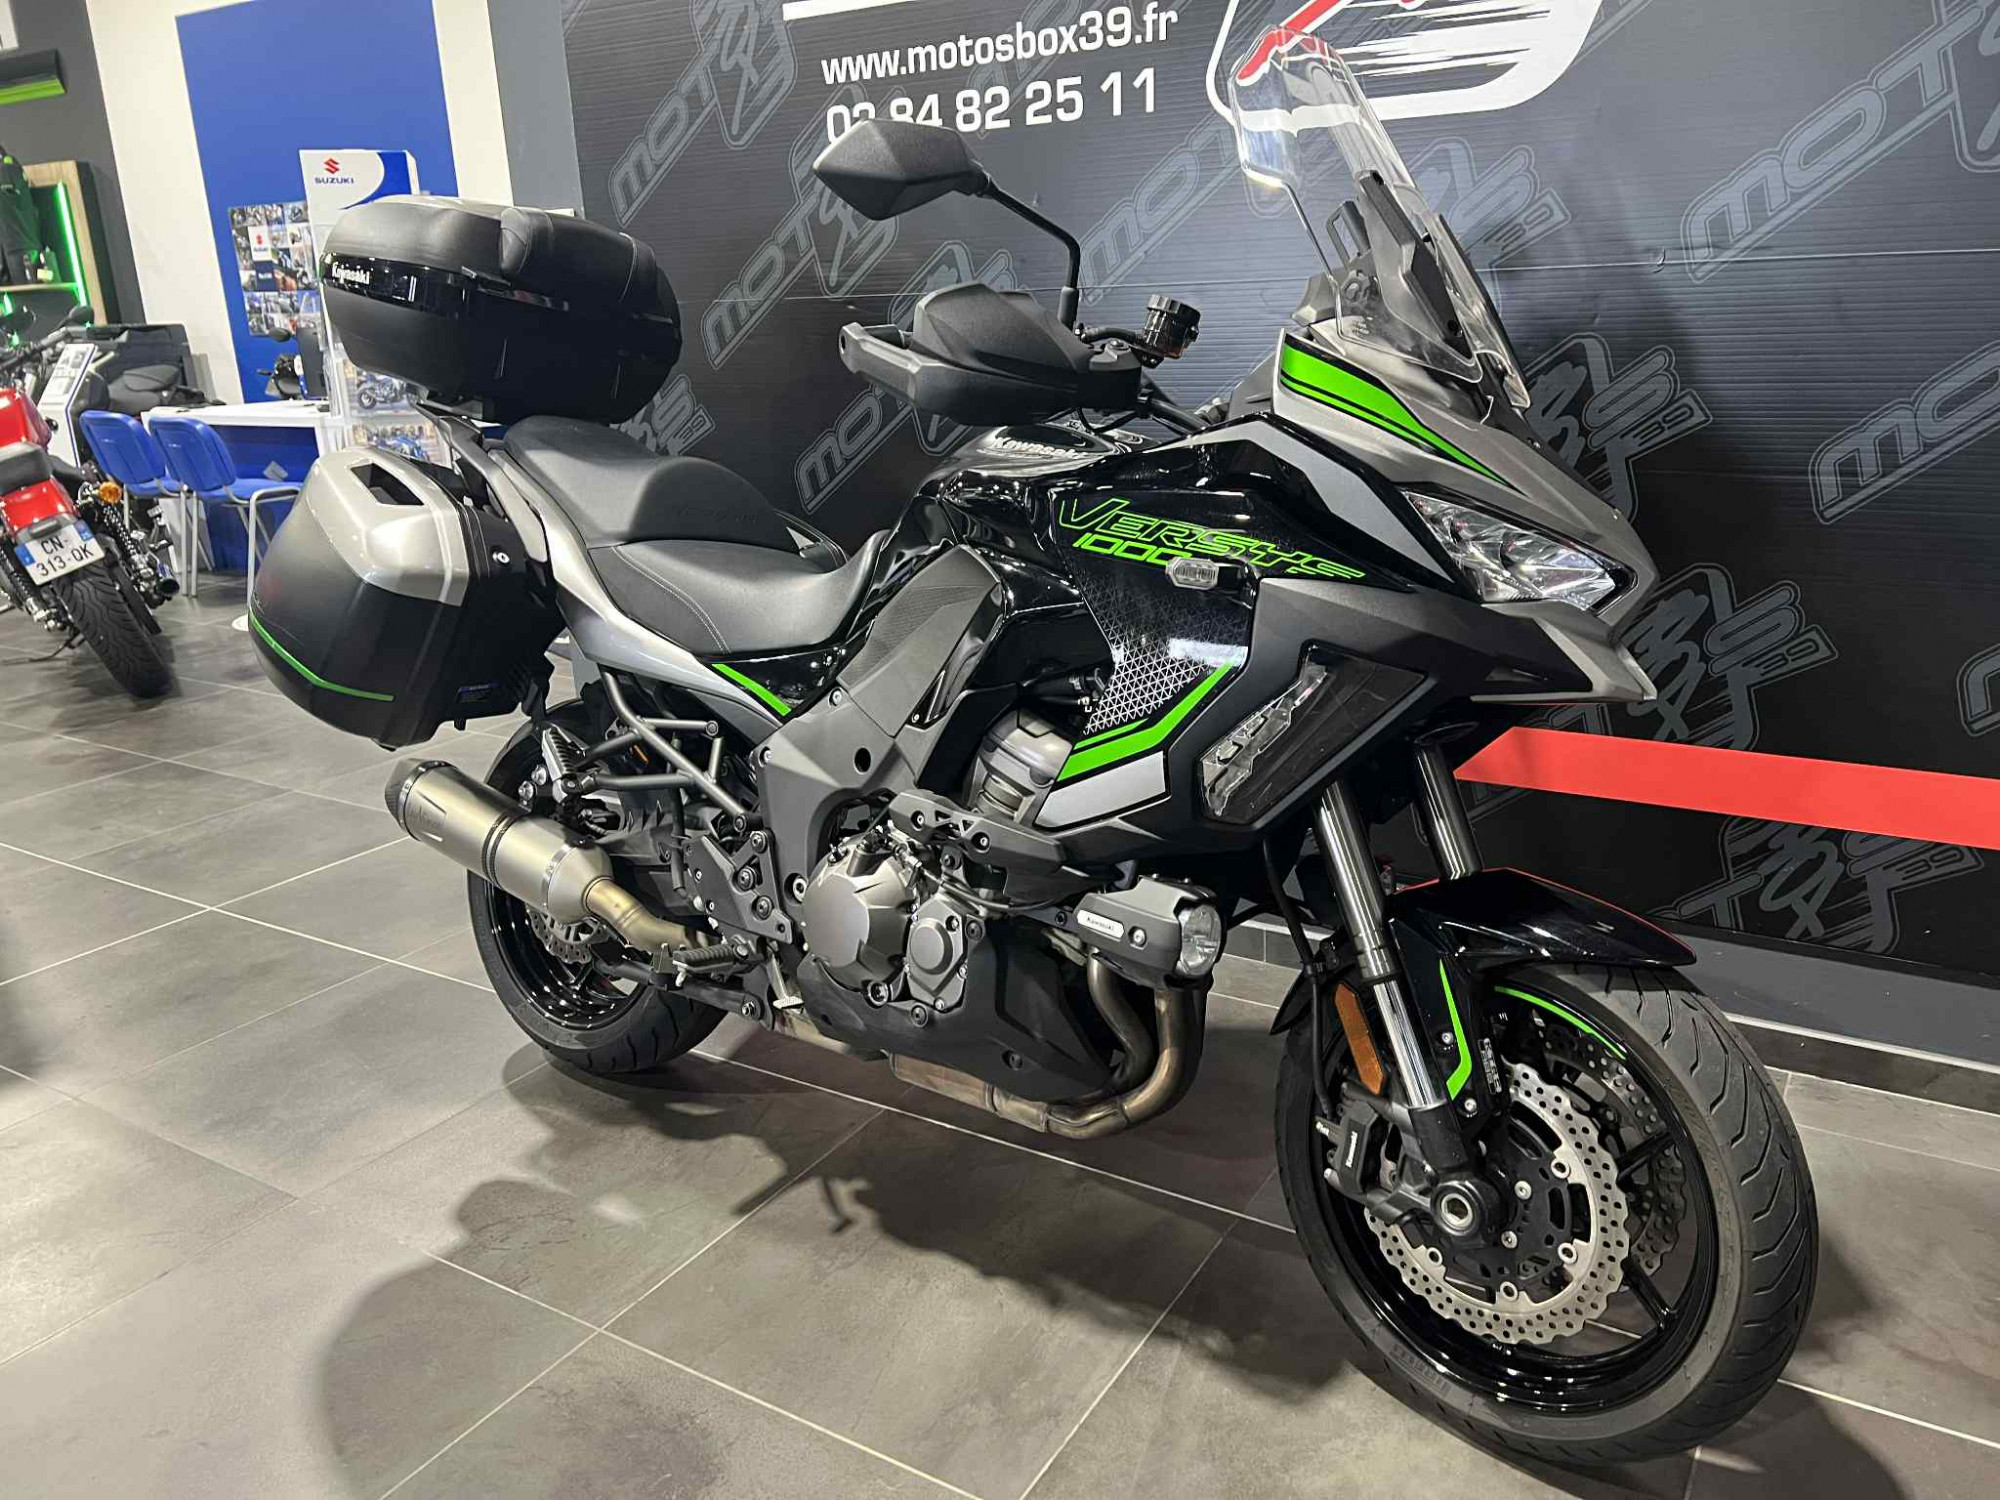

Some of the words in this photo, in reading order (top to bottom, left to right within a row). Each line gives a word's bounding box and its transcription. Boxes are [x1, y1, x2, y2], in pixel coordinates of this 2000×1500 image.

[821, 4, 1178, 85] www.motosbox39.fr
[955, 85, 1011, 132] 82
[1025, 76, 1084, 126] 25
[1100, 67, 1155, 117] 11
[315, 177, 354, 185] SUZUKI
